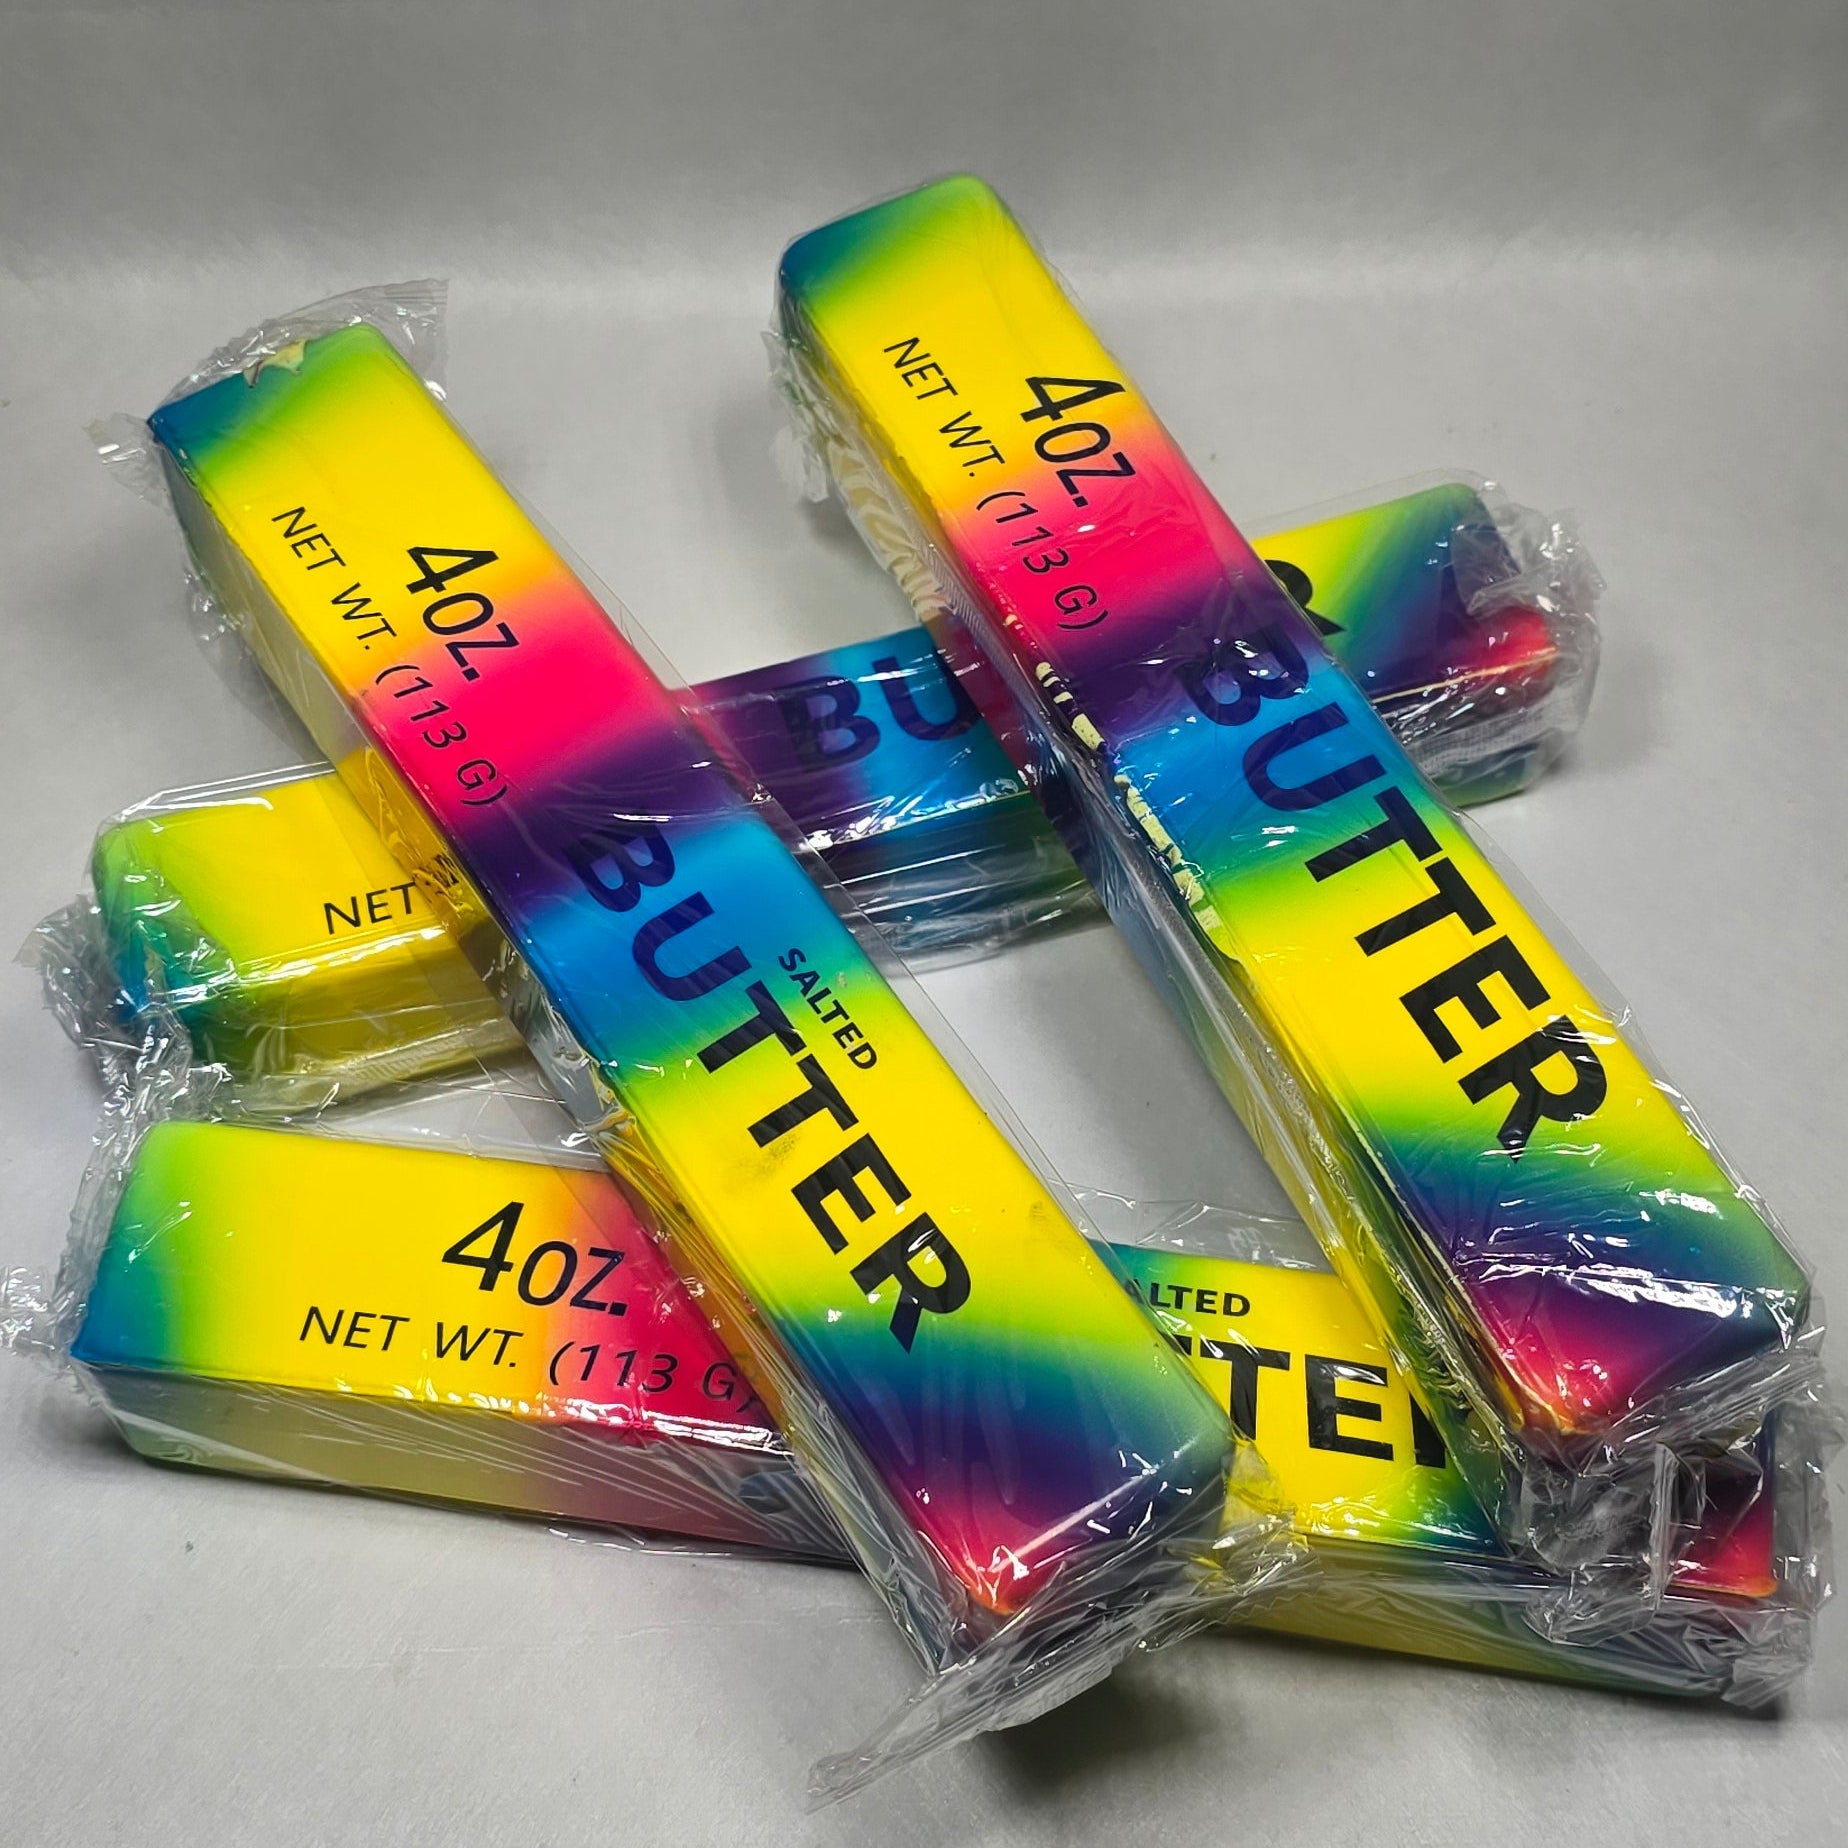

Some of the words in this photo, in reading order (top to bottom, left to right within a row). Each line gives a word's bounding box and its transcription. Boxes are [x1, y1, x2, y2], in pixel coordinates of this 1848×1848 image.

[883, 337, 959, 401] NET
[939, 411, 1006, 478] WT.
[976, 491, 1069, 574] (113
[1053, 584, 1109, 631] G)
[272, 506, 346, 571] NET
[330, 582, 397, 650] WT.
[375, 664, 468, 749] (113
[455, 758, 508, 807] G)
[323, 881, 415, 935] NET
[1172, 623, 1607, 1163] BUTTER
[778, 947, 878, 1071] SALTED
[562, 808, 971, 1354] BUTTER
[299, 1306, 410, 1351] NET
[435, 1321, 524, 1368] WT.
[549, 1341, 678, 1393] (113
[1131, 1279, 1250, 1317] LTED
[1158, 1333, 1446, 1468] TE
